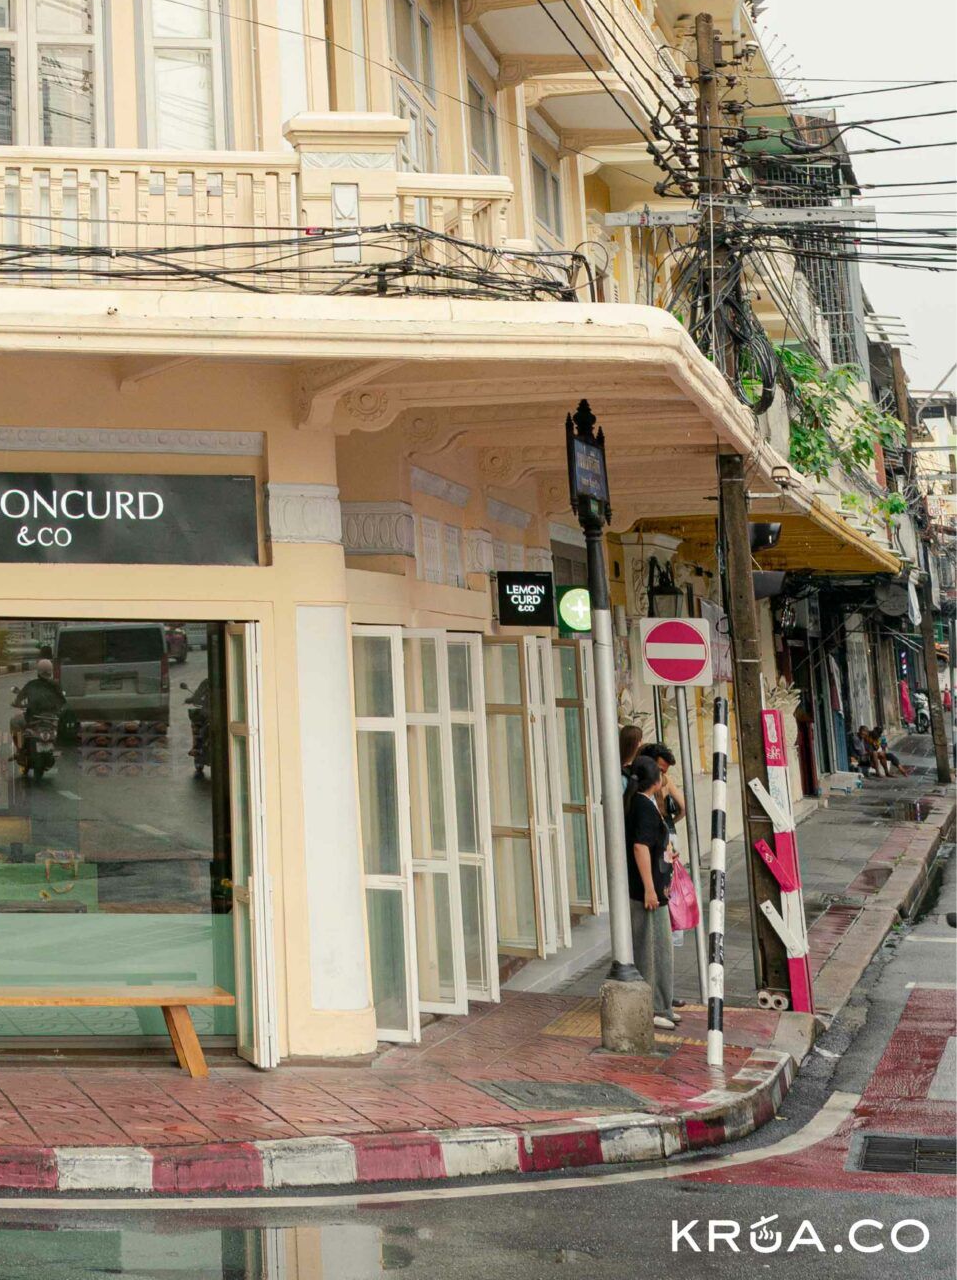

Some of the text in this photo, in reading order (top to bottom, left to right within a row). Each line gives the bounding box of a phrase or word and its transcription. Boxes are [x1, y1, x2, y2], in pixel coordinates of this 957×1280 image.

[16, 525, 72, 548] &CO
[506, 584, 545, 595] LEMON
[511, 595, 541, 605] CURD
